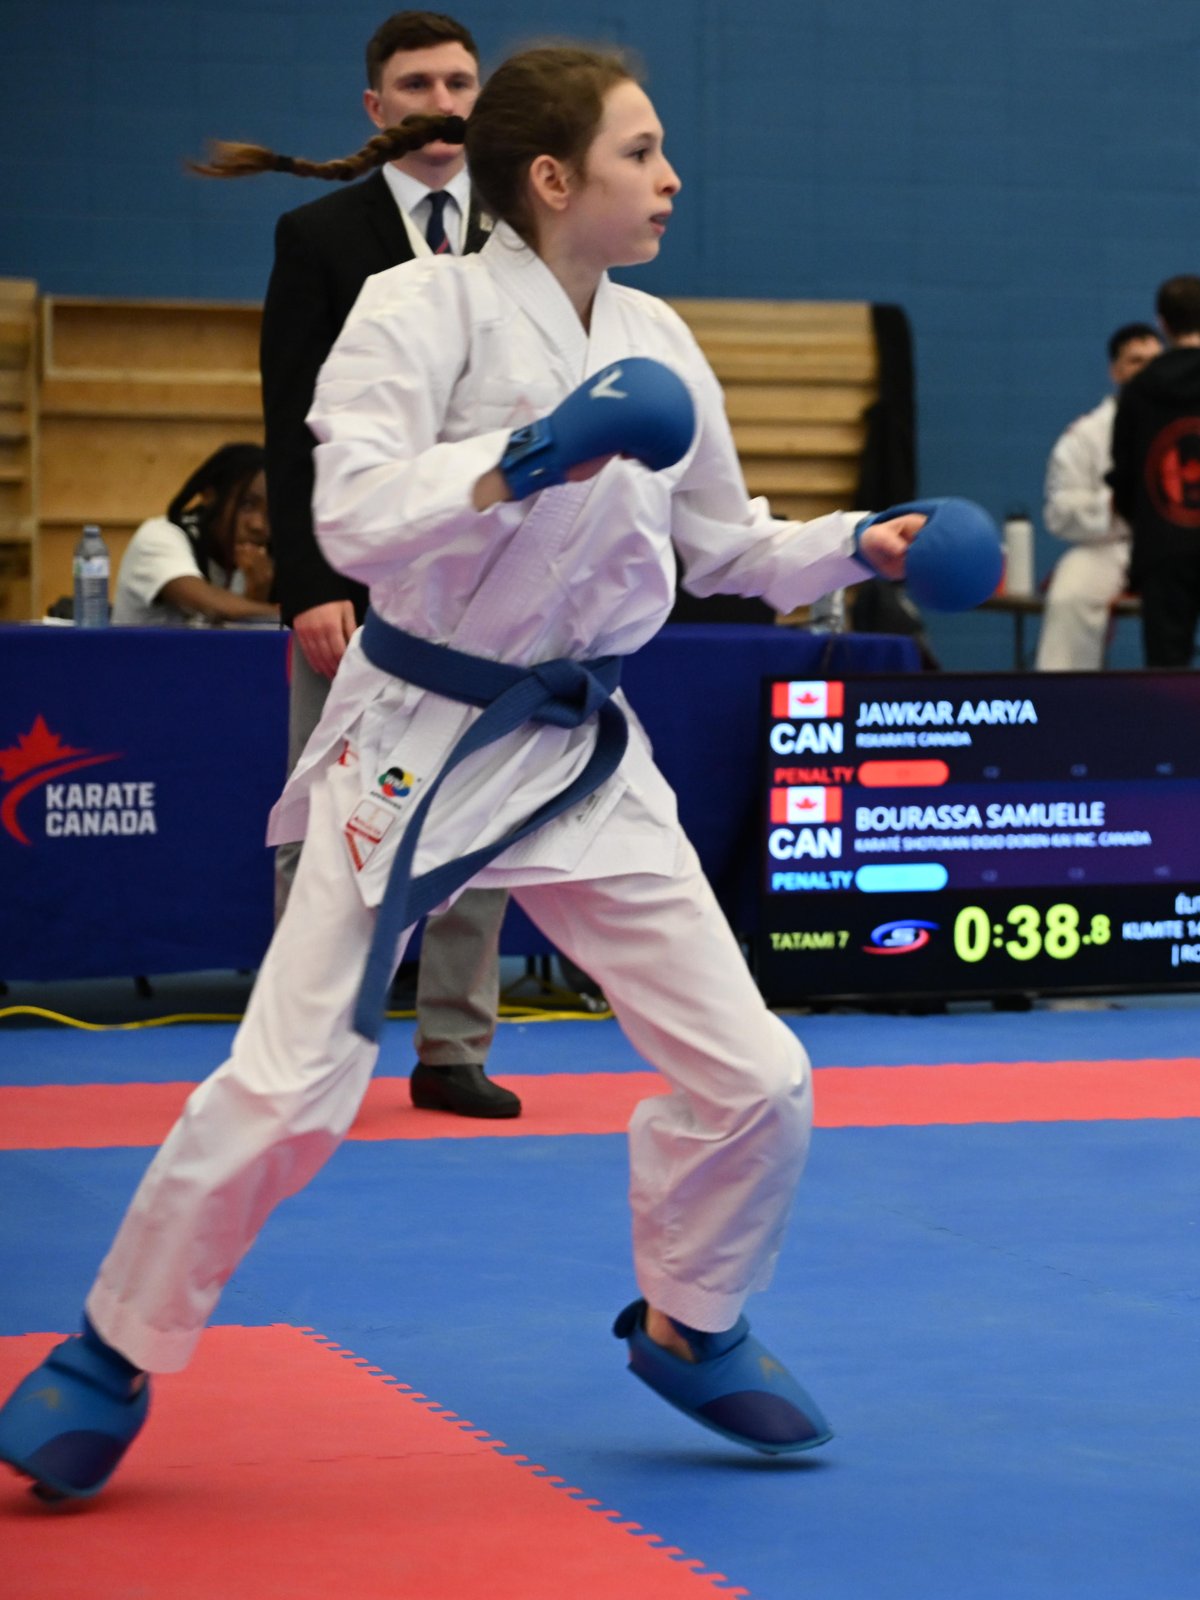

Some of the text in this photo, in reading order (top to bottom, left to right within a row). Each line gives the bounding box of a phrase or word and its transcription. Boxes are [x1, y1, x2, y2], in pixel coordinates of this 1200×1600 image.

[856, 699, 1038, 727] JAWKAR AARYA
[770, 722, 844, 755] CAN
[917, 731, 973, 747] CANADA
[774, 766, 854, 784] PENALTY
[46, 782, 156, 810] KARATE
[46, 809, 157, 837] CANADA
[855, 801, 1105, 831] BOURASSA SAMUELLE
[768, 827, 842, 860] CAN
[772, 870, 853, 891] PENALTY
[770, 930, 850, 949] TATAMI 7
[1122, 919, 1184, 941] KUMITE
